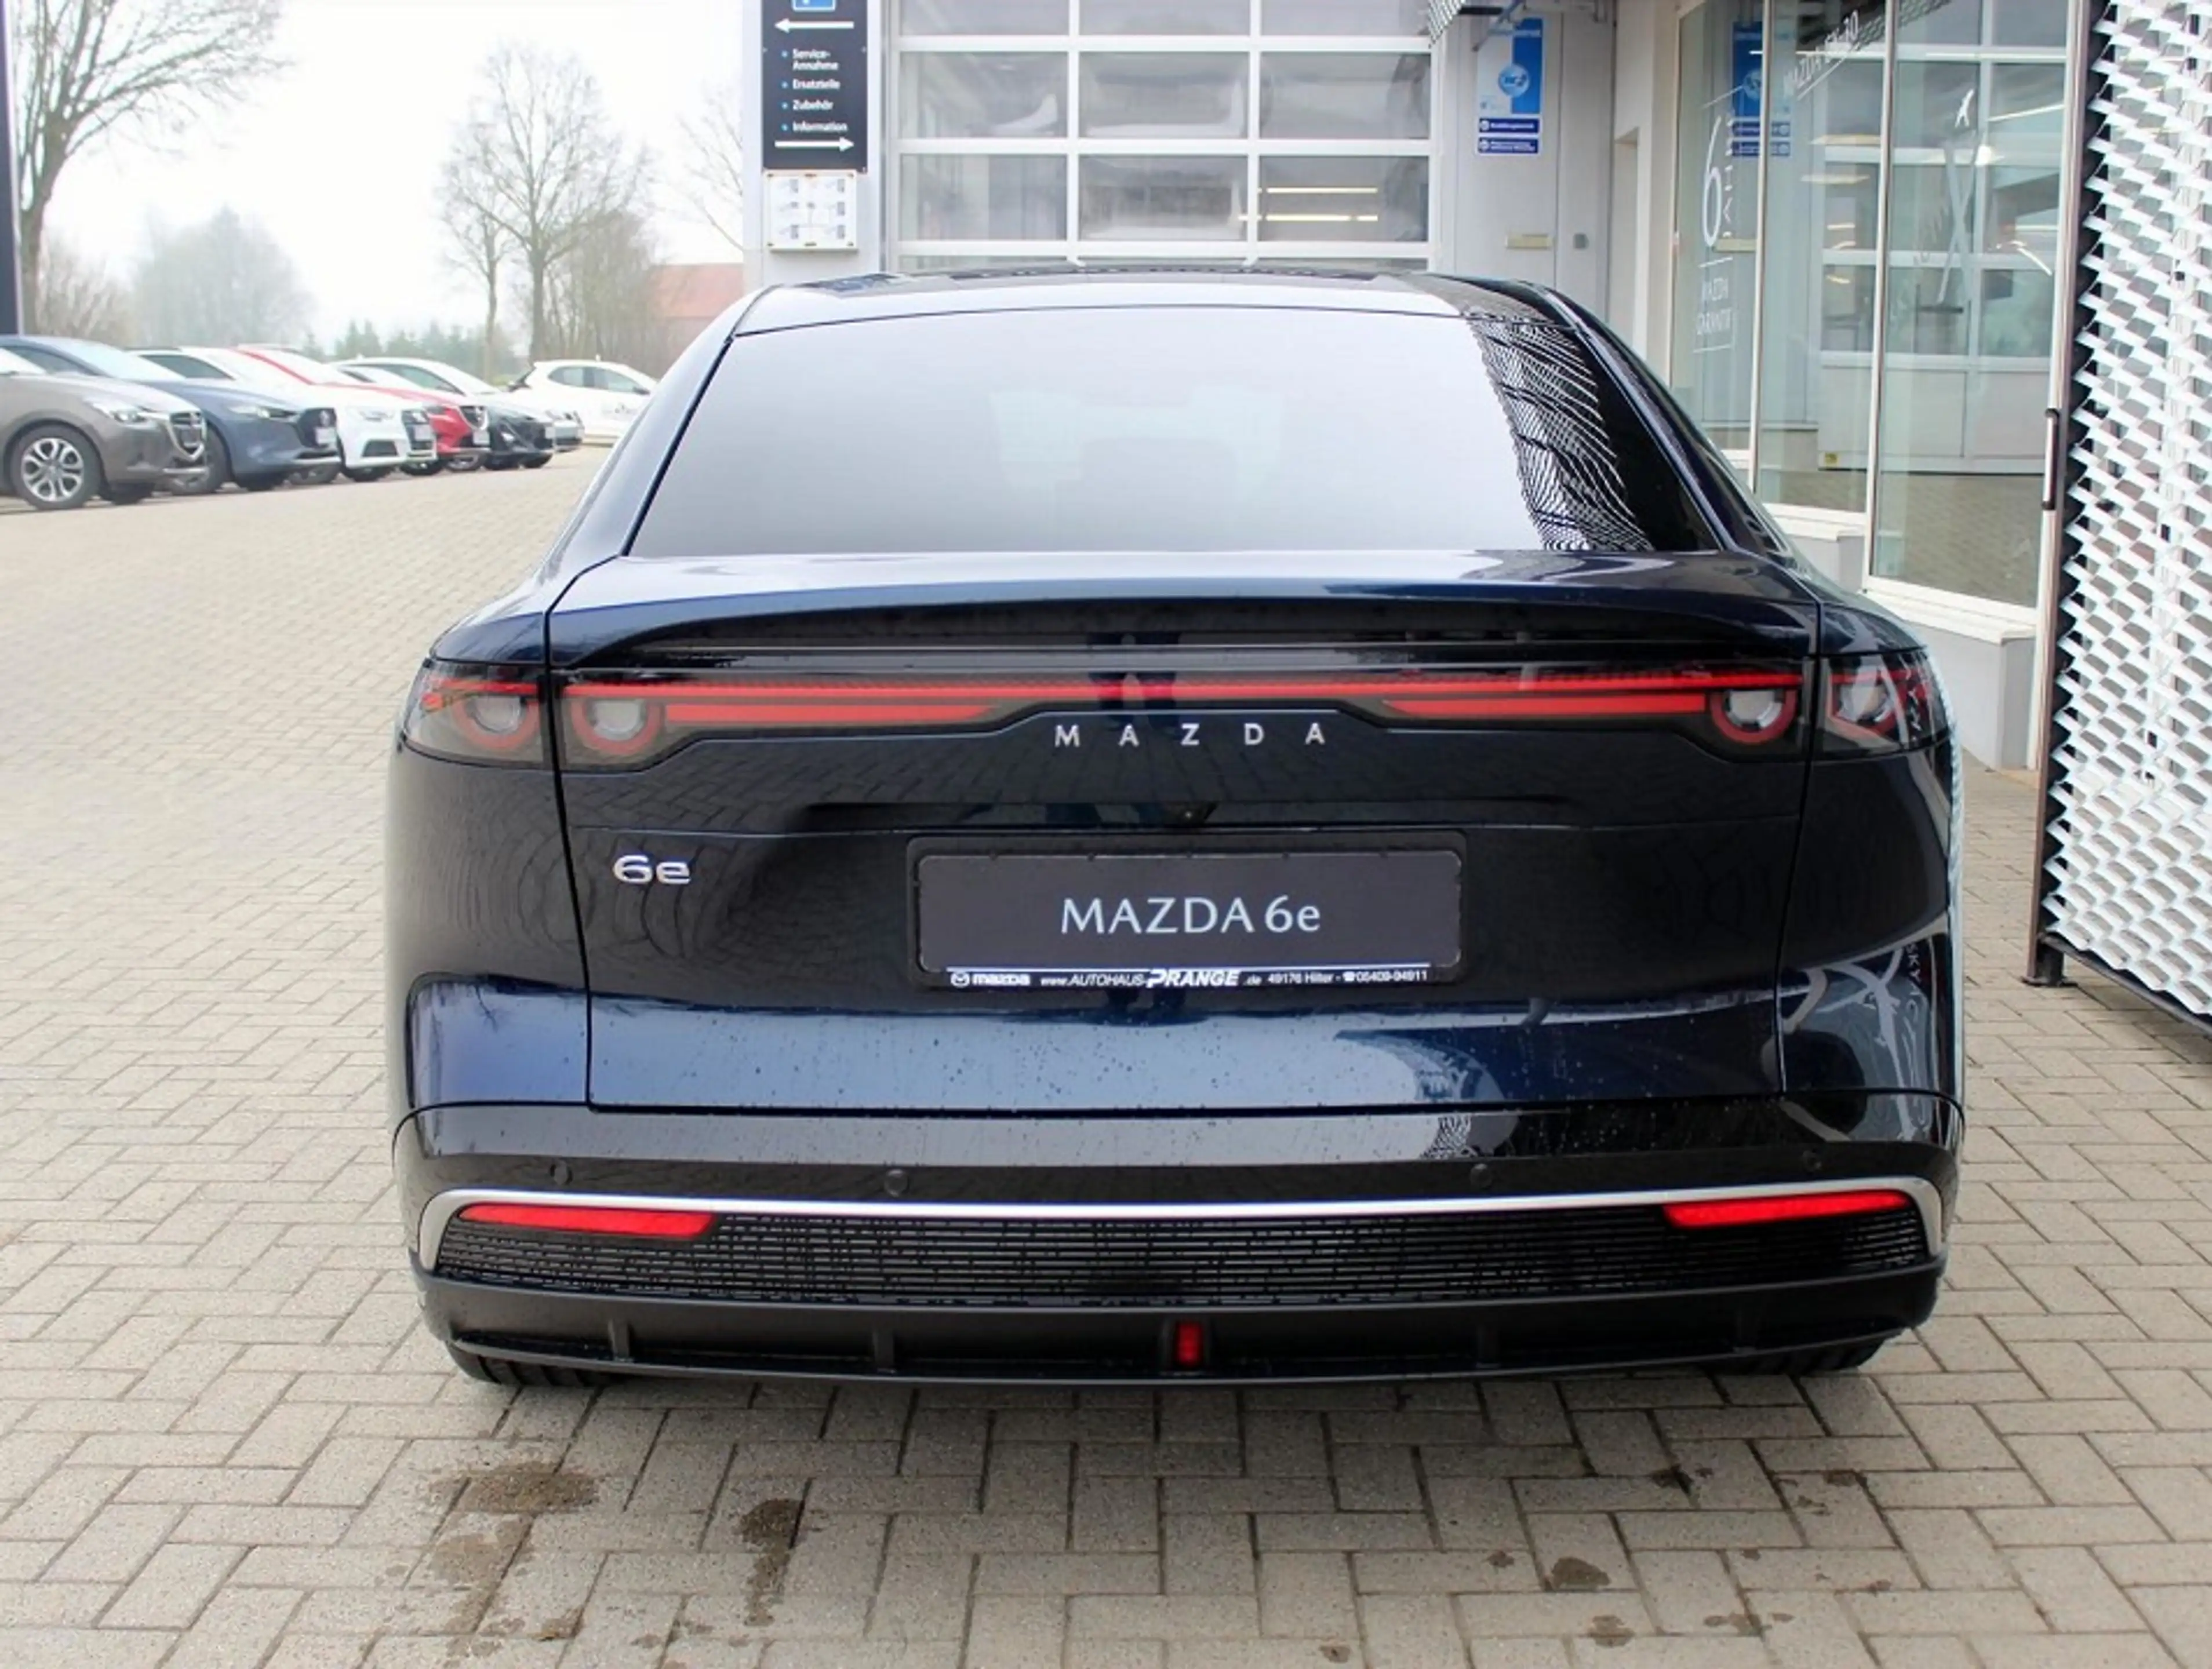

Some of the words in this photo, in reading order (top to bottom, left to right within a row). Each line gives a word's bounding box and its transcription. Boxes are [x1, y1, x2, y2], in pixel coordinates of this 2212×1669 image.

[792, 60, 839, 70] Annahme
[792, 78, 841, 89] Ersatzteile
[792, 99, 834, 110] Zubehör
[792, 120, 849, 132] Information
[1054, 723, 1326, 748] MAZDA
[614, 855, 691, 884] 6e
[972, 973, 1031, 985] mazda
